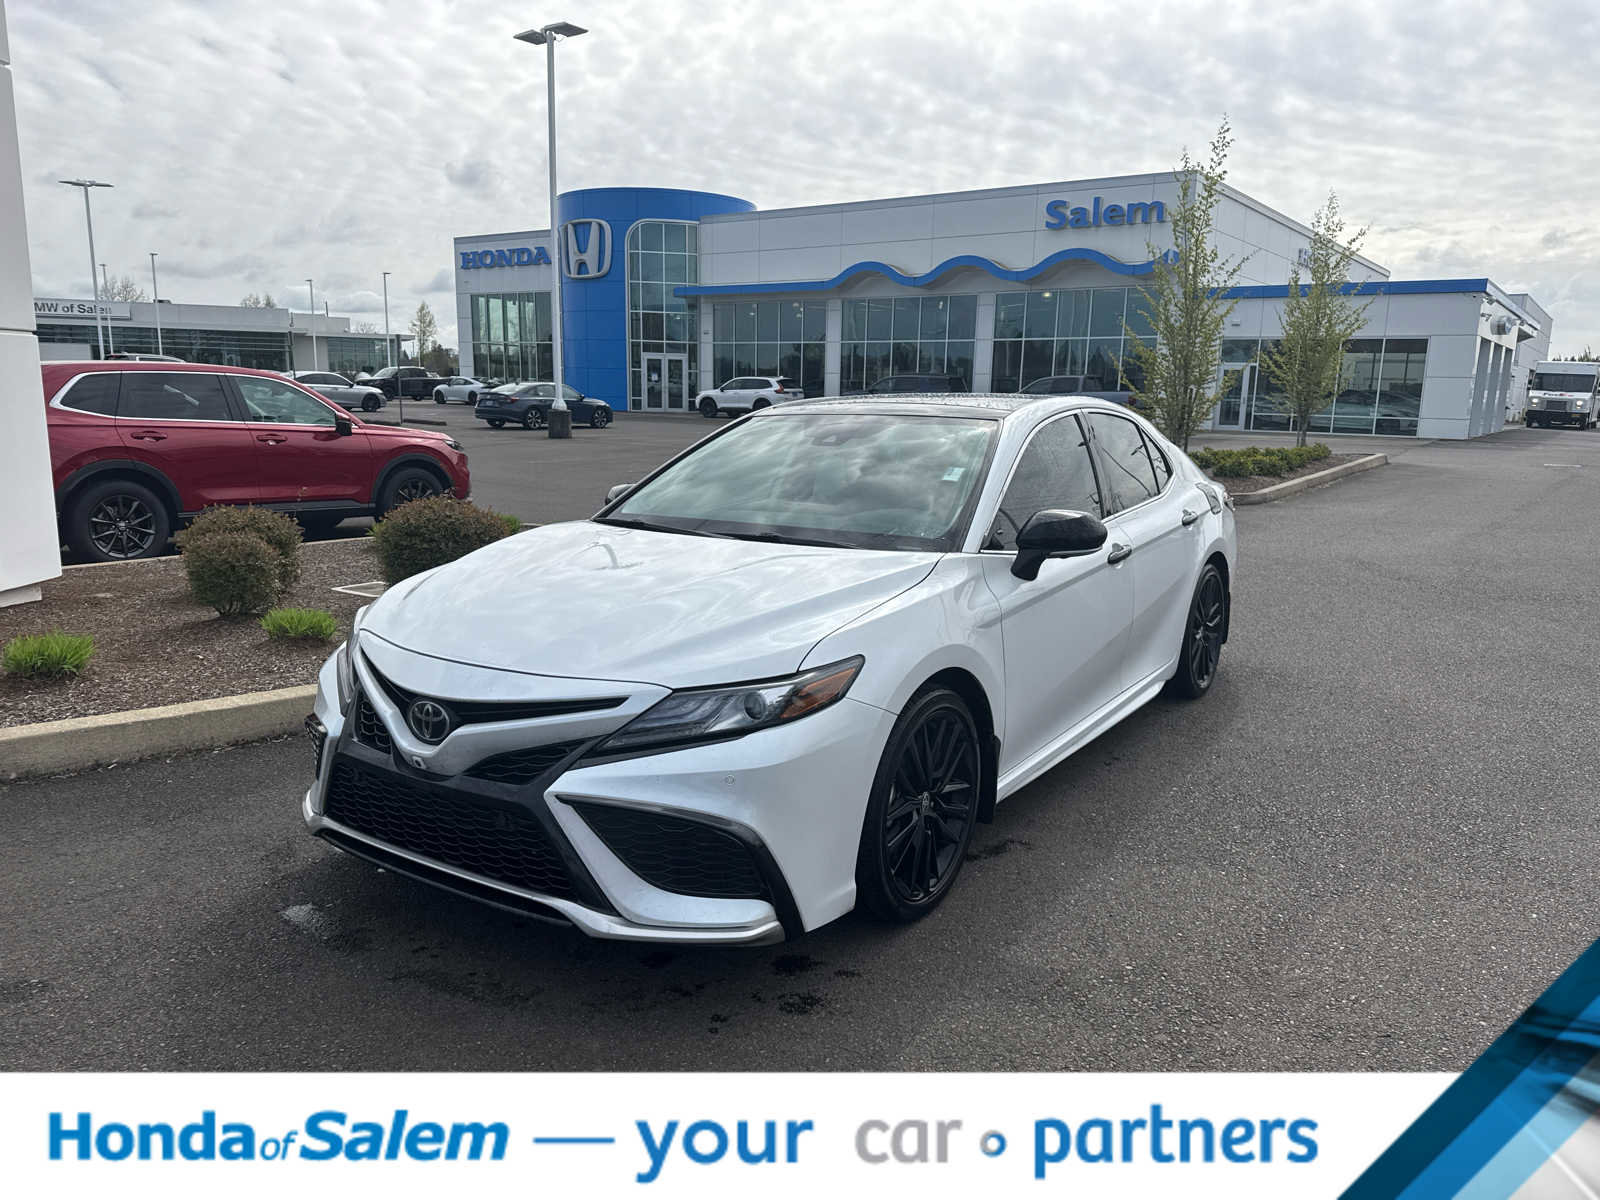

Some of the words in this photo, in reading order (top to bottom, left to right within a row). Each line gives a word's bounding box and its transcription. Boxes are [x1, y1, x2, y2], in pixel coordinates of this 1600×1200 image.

[1045, 196, 1165, 230] Salem
[460, 246, 552, 269] HONDA
[34, 302, 58, 313] MW
[62, 303, 74, 313] of
